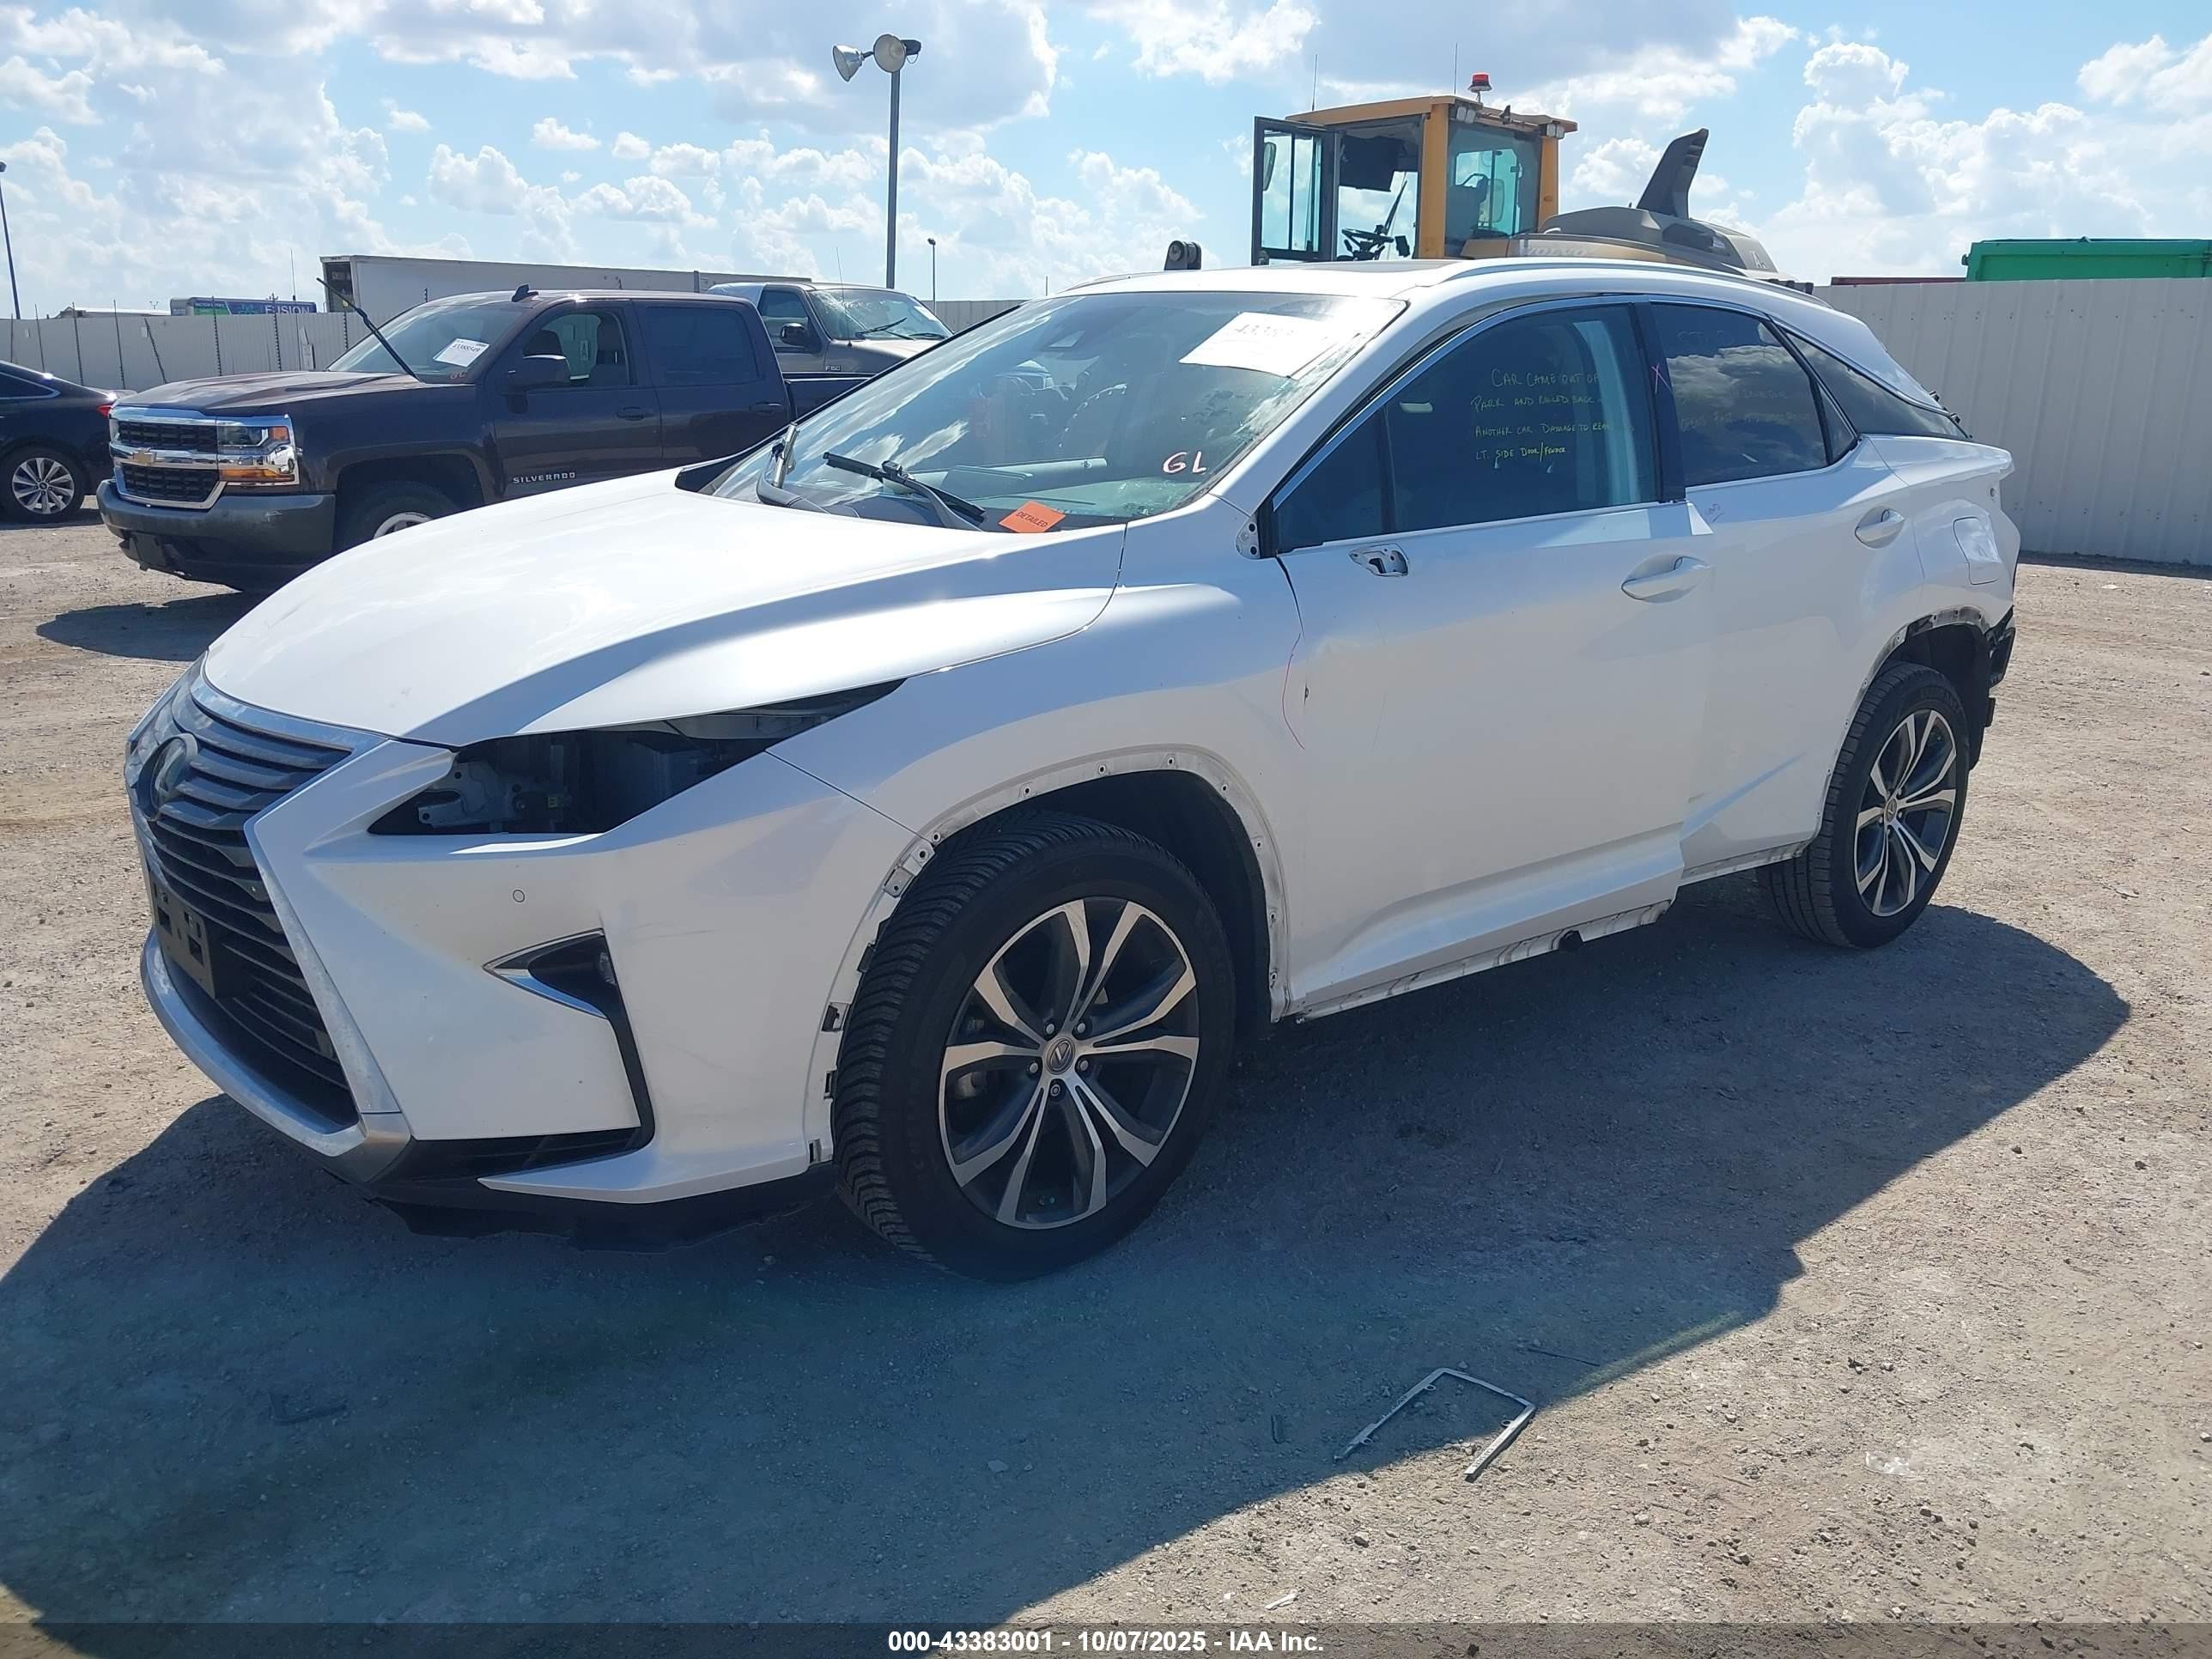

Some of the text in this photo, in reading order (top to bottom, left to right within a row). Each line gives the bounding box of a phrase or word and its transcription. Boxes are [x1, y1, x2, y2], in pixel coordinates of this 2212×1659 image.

[1527, 246, 1588, 256] VOLVO
[1491, 368, 1522, 387] CAR
[1527, 372, 1556, 386] CAME
[1561, 373, 1584, 385] OUT
[1470, 395, 1504, 412] PARK
[1514, 396, 1534, 406] AND
[1571, 395, 1595, 404] BACK
[1475, 425, 1513, 437] ANOTHER
[1539, 422, 1576, 433] DAMAGE
[1163, 450, 1207, 474] GL
[1496, 449, 1515, 459] SIDE
[513, 471, 576, 483] SILVERADO
[1016, 511, 1048, 528] DETAILED
